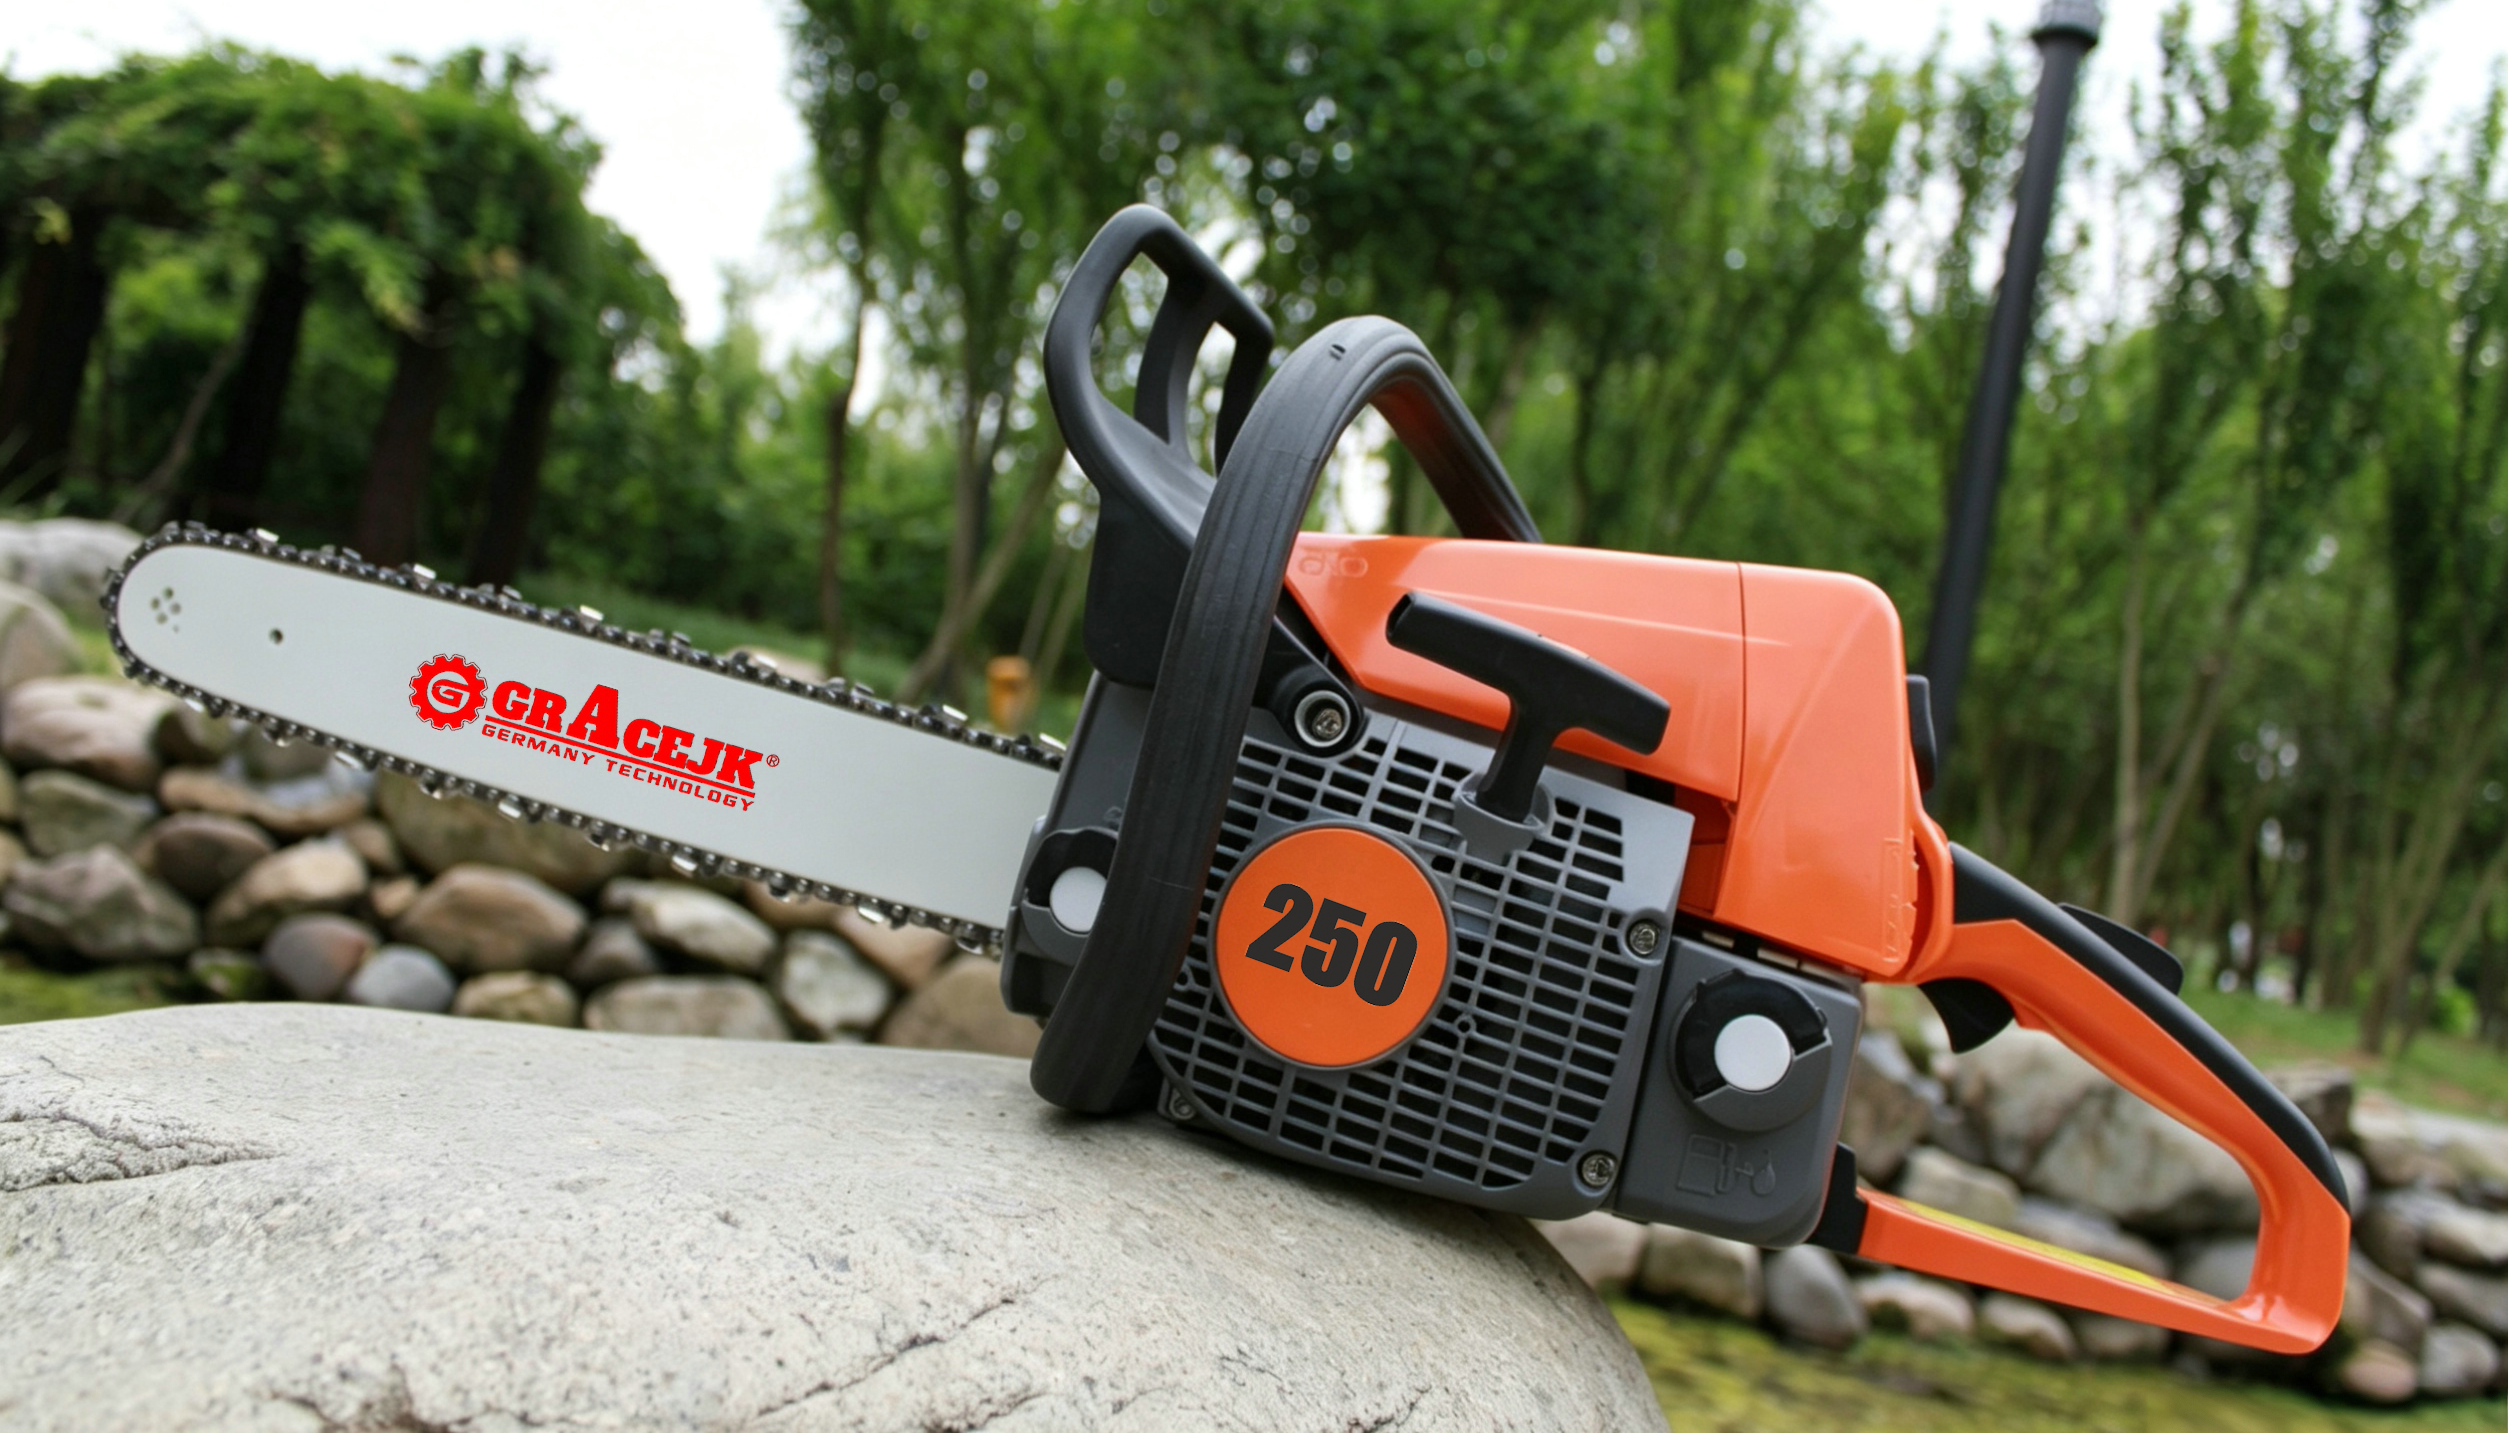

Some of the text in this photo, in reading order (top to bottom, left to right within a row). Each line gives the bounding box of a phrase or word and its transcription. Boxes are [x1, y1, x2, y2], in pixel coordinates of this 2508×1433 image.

[481, 724, 755, 812] GERMANY TECHNOLOGY
[1245, 883, 1418, 1007] 250
